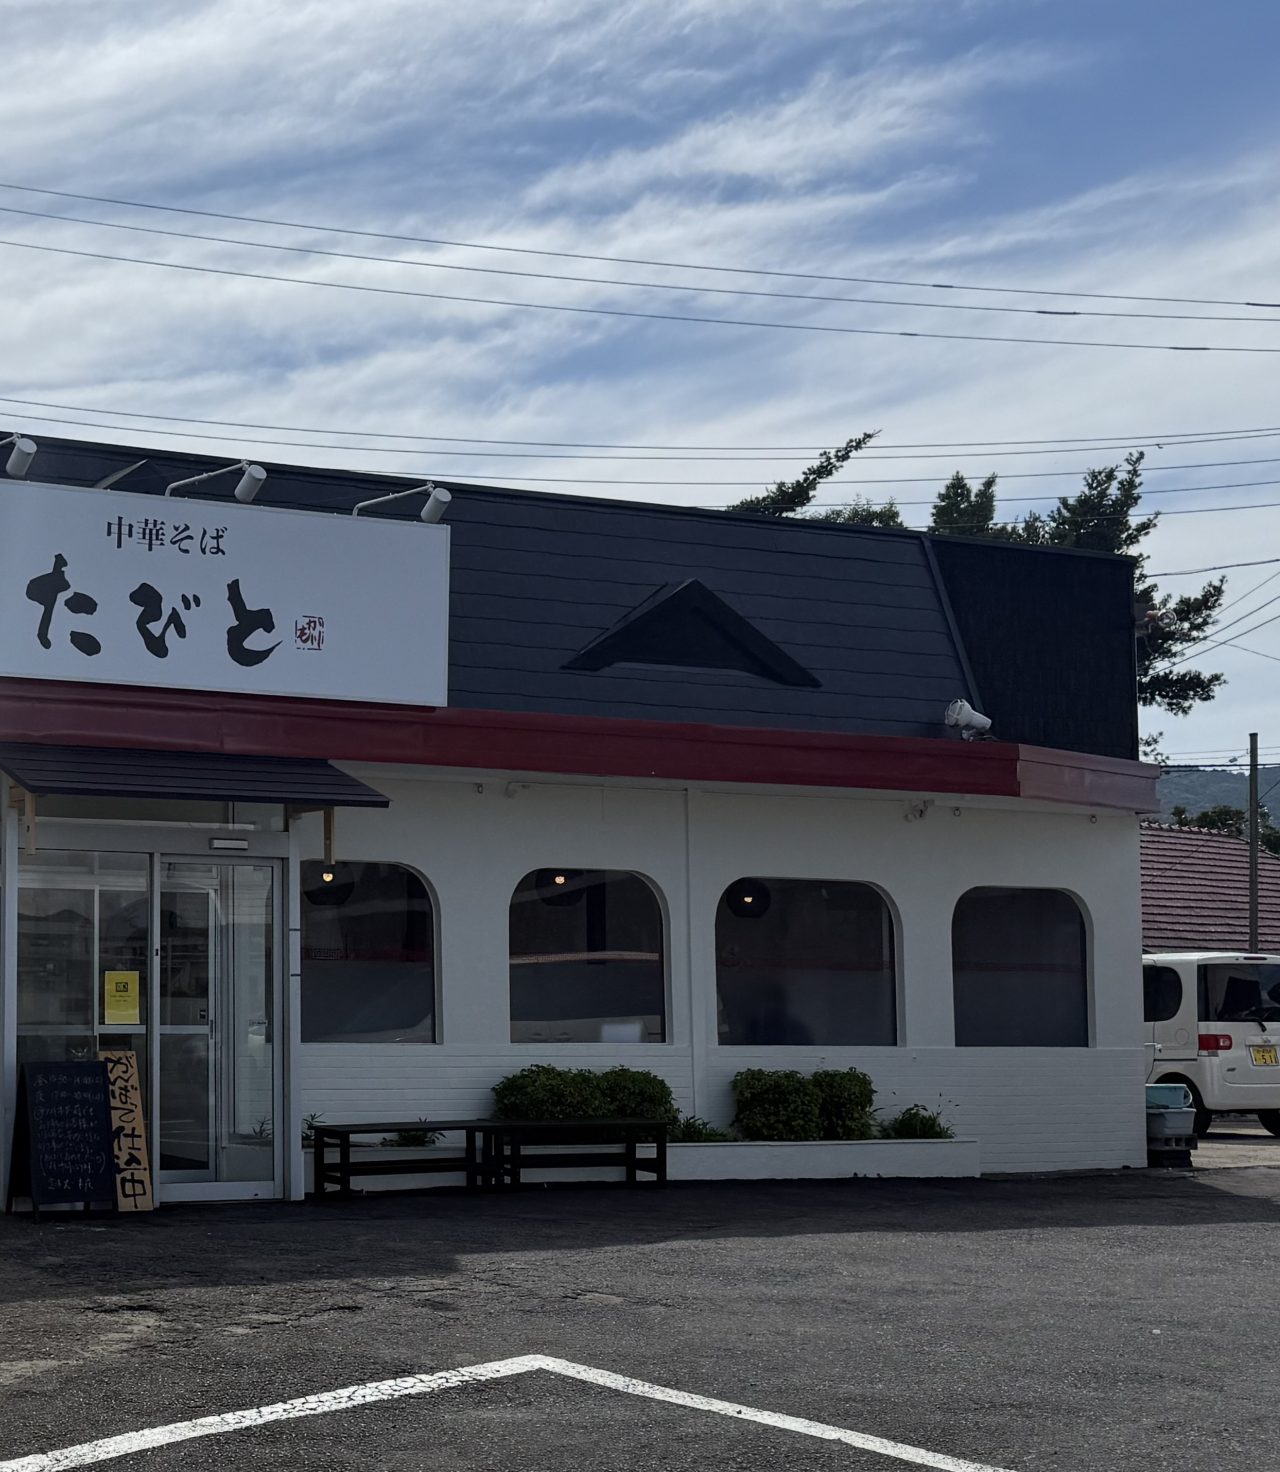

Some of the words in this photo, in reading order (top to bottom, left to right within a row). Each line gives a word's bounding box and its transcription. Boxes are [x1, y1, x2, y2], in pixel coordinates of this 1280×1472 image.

[106, 515, 228, 556] 中華そば
[26, 553, 284, 667] たびと
